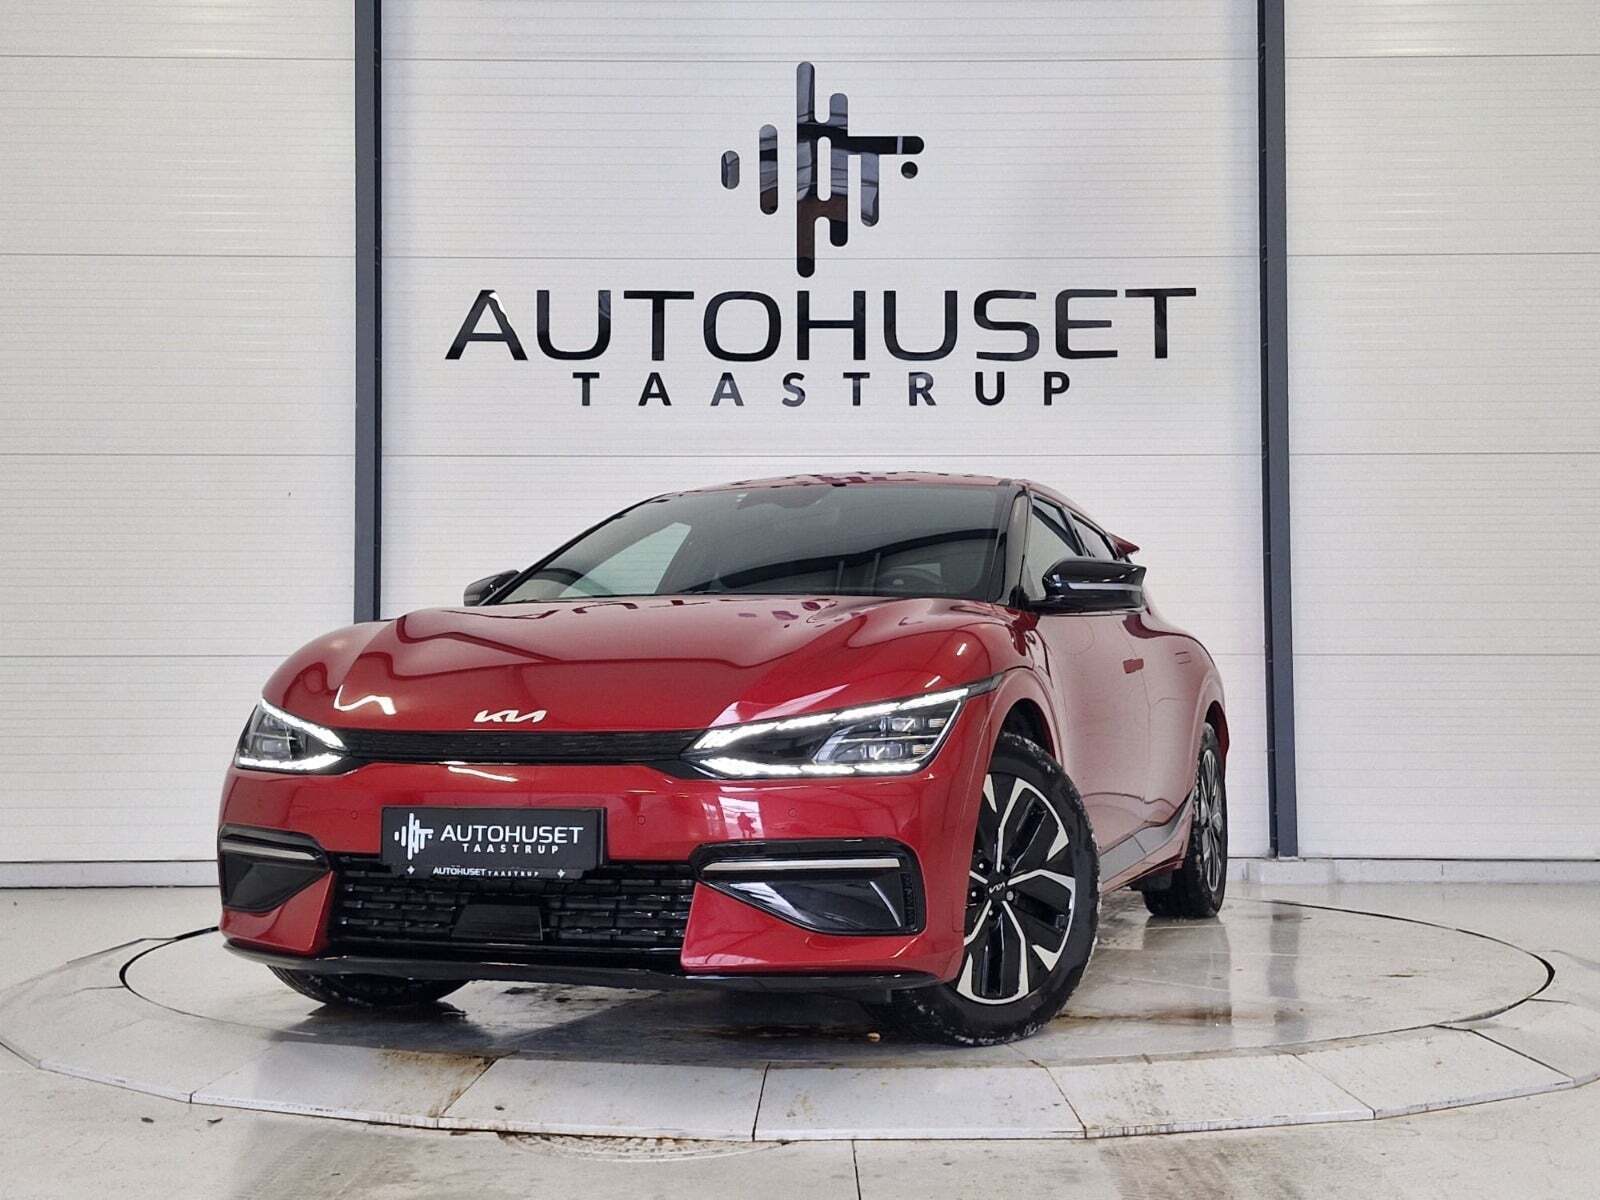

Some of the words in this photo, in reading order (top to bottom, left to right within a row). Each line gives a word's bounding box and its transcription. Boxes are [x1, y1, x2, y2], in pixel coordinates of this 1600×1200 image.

[444, 287, 1197, 362] AUTOHUSET
[572, 371, 1071, 407] TAASTRUP
[473, 709, 547, 723] KIA
[440, 824, 584, 844] AUTOHUSET
[462, 843, 559, 854] TAASTRUP
[432, 866, 487, 876] AUTOHUSET
